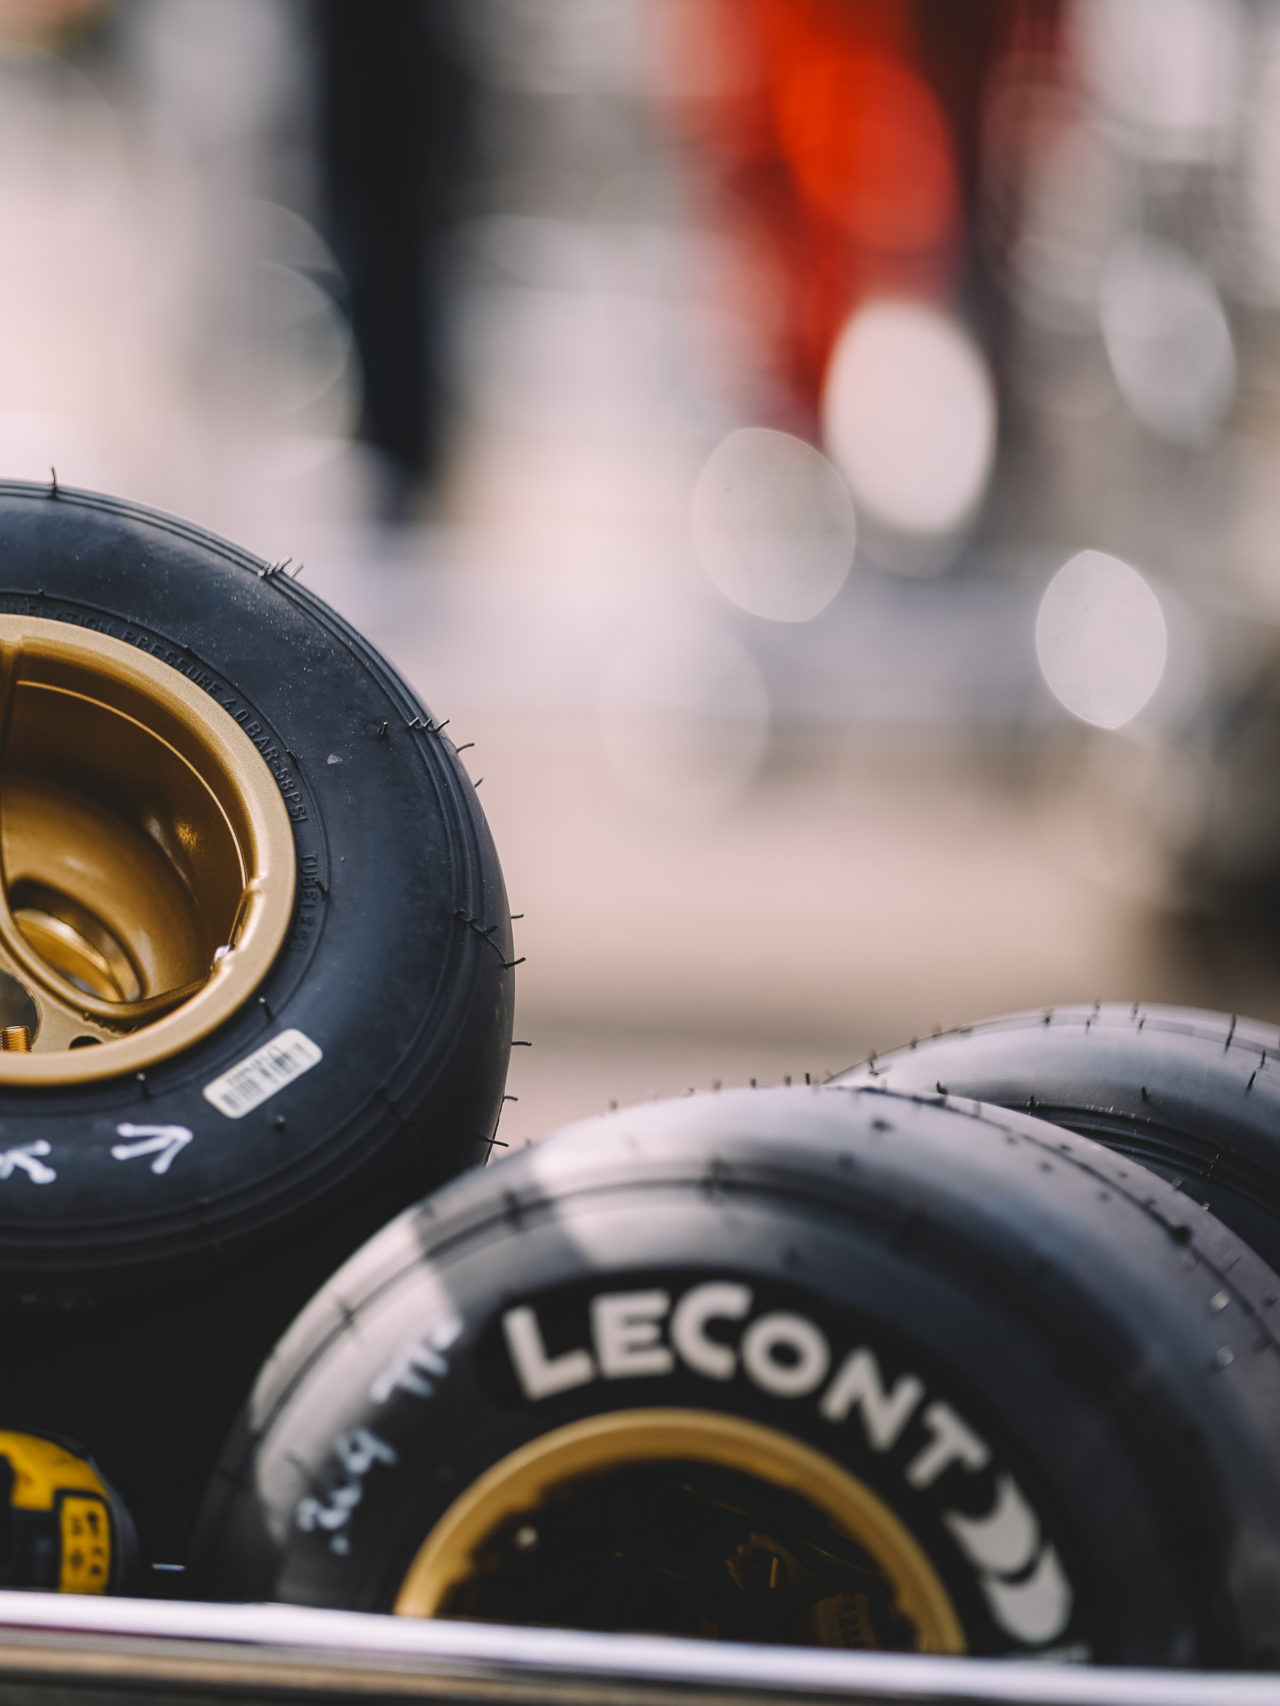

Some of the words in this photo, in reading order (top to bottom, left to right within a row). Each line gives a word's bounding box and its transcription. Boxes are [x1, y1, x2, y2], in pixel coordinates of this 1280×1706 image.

[121, 629, 222, 698] PRESSURE
[291, 853, 320, 955] TUBELESS
[504, 1283, 988, 1482] LECONT
